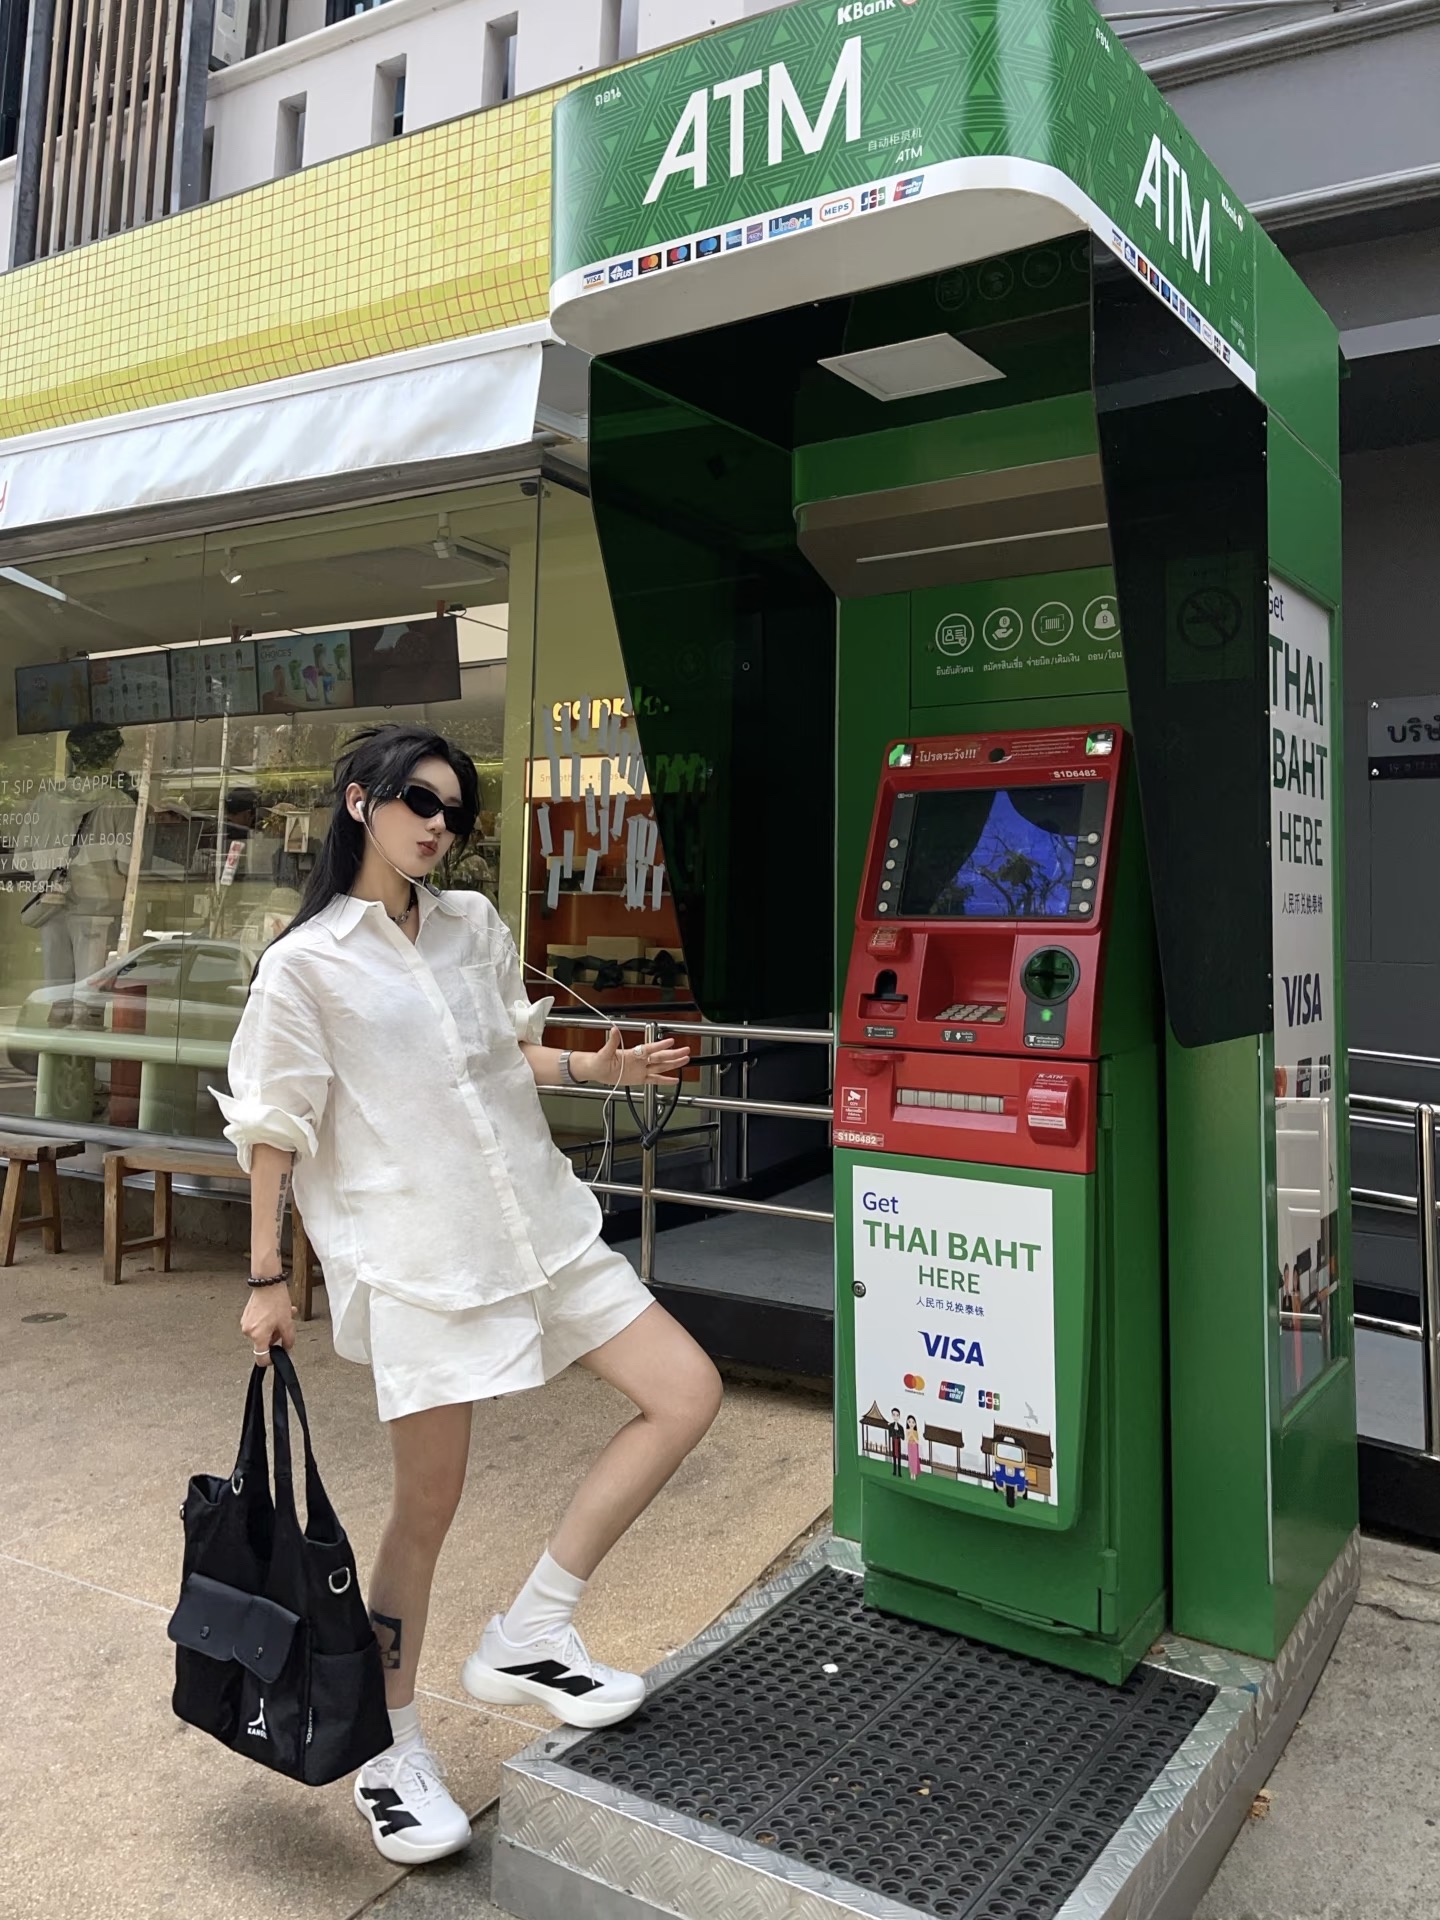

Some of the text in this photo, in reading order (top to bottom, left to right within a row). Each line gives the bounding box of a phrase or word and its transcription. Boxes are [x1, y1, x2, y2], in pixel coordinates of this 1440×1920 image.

[837, 0, 896, 26] KBank
[642, 35, 862, 206] ATM
[867, 127, 923, 152] 自动柜员机
[895, 145, 923, 164] ATM
[824, 203, 850, 217] MEPS
[861, 190, 886, 207] JCB
[1134, 133, 1211, 287] ATM
[586, 274, 601, 285] VISA
[615, 269, 632, 281] PLUS
[1269, 633, 1323, 726] THAI
[1053, 769, 1097, 779] S1D6482
[1272, 727, 1328, 800] BAHT
[13, 779, 34, 795] SIP
[38, 777, 67, 793] AND
[72, 773, 125, 793] GAPPLE
[24, 835, 40, 848] FIX
[54, 833, 95, 847] ACTIVE
[1279, 811, 1323, 867] HERE
[12, 857, 28, 870] NO
[1281, 973, 1323, 1028] VISA
[837, 1131, 877, 1145] S1D6482
[862, 1191, 899, 1214] Get
[862, 1219, 1042, 1273] THAI BAHT
[918, 1264, 981, 1295] HERE
[917, 1330, 985, 1368] VISA
